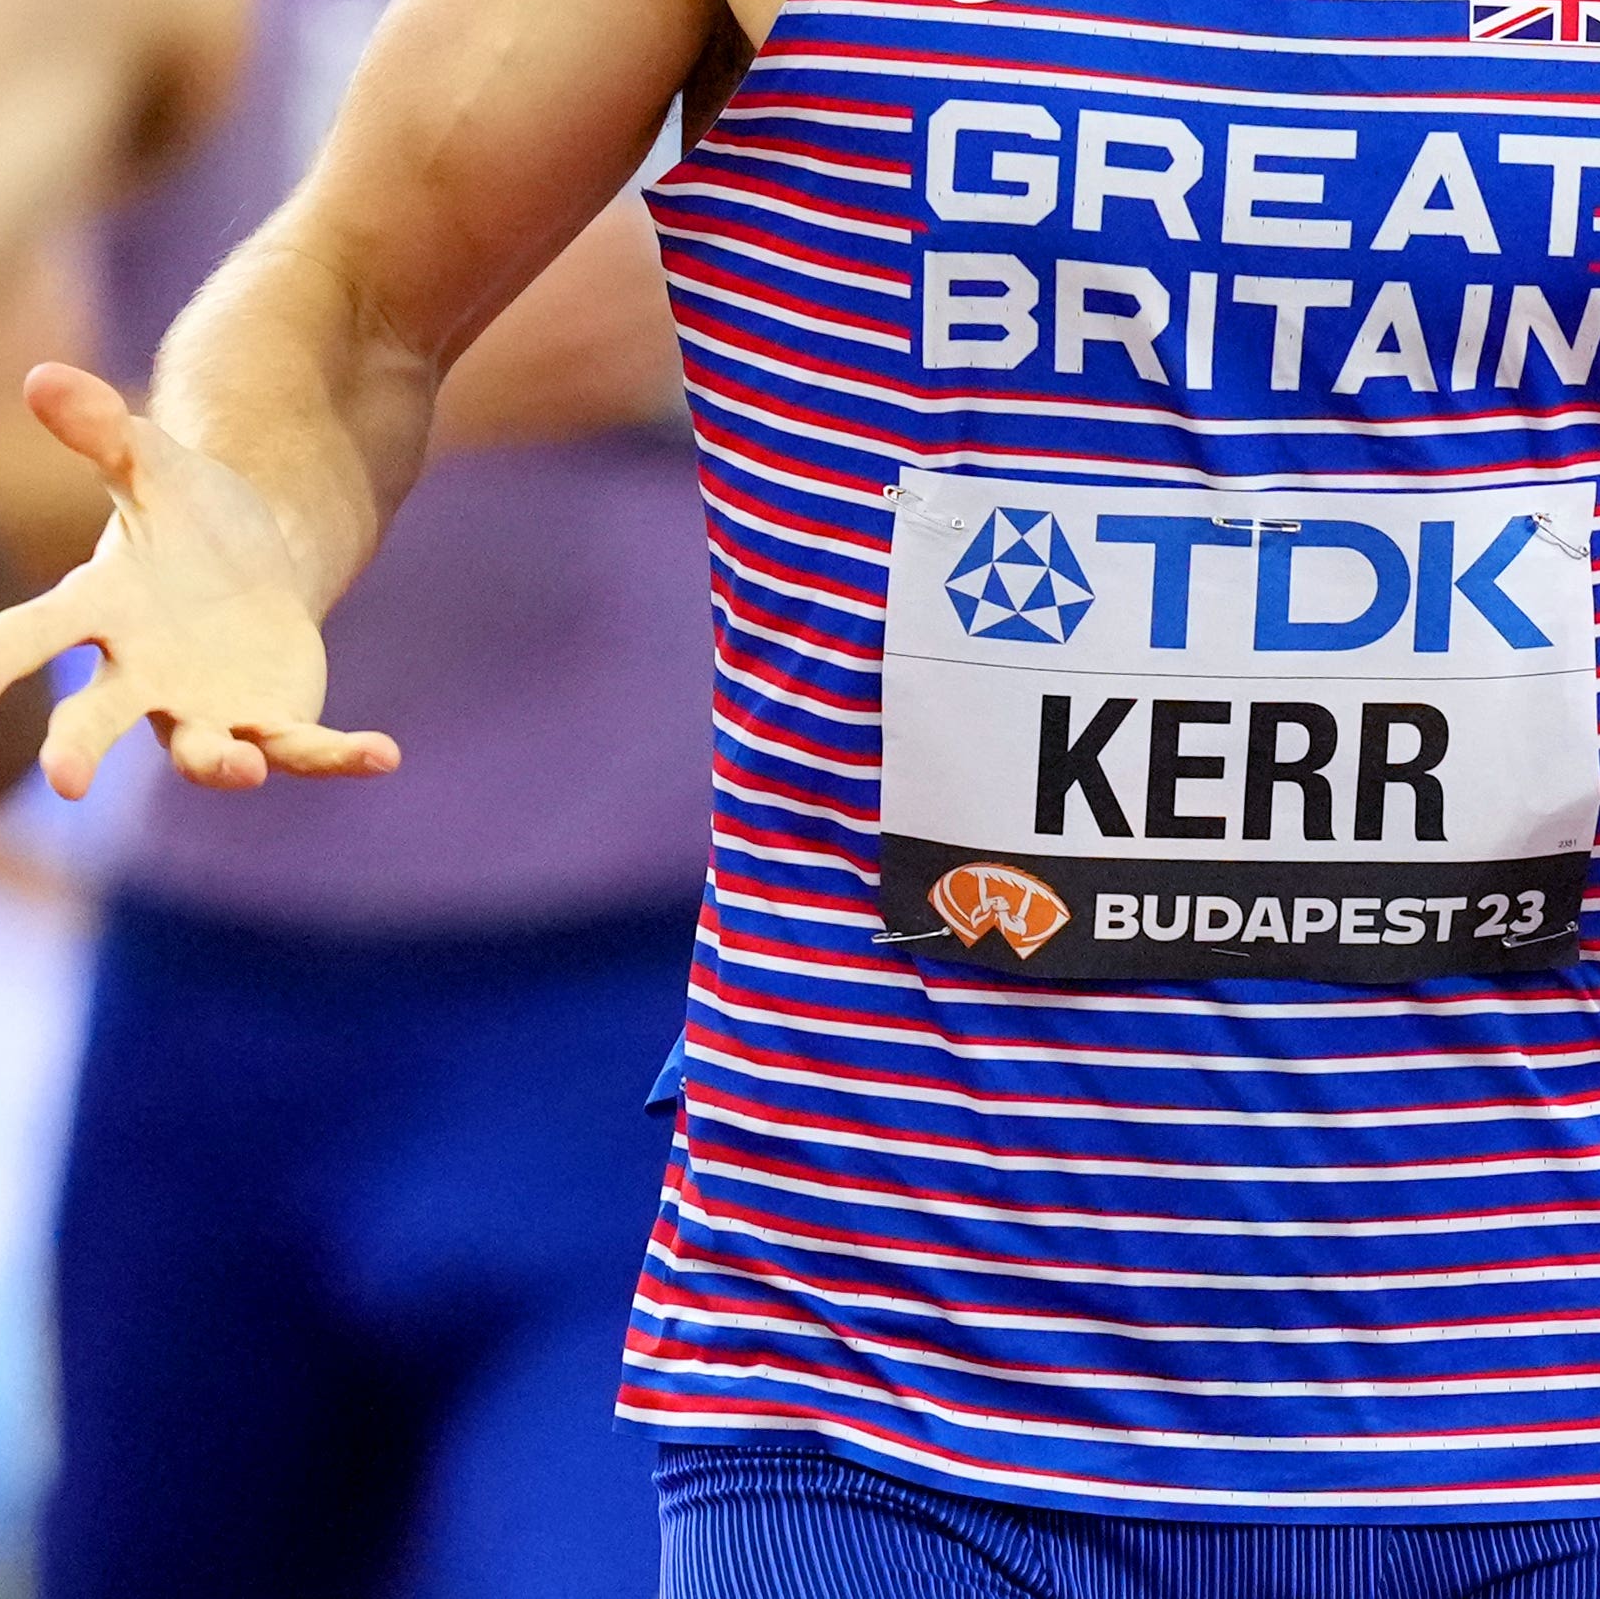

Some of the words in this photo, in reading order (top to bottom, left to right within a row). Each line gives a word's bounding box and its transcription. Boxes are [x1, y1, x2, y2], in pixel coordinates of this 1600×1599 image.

[1094, 512, 1555, 654] TDK
[1033, 693, 1451, 844] KERR
[1093, 892, 1468, 945] BUDAPEST
[1472, 889, 1547, 938] 23
